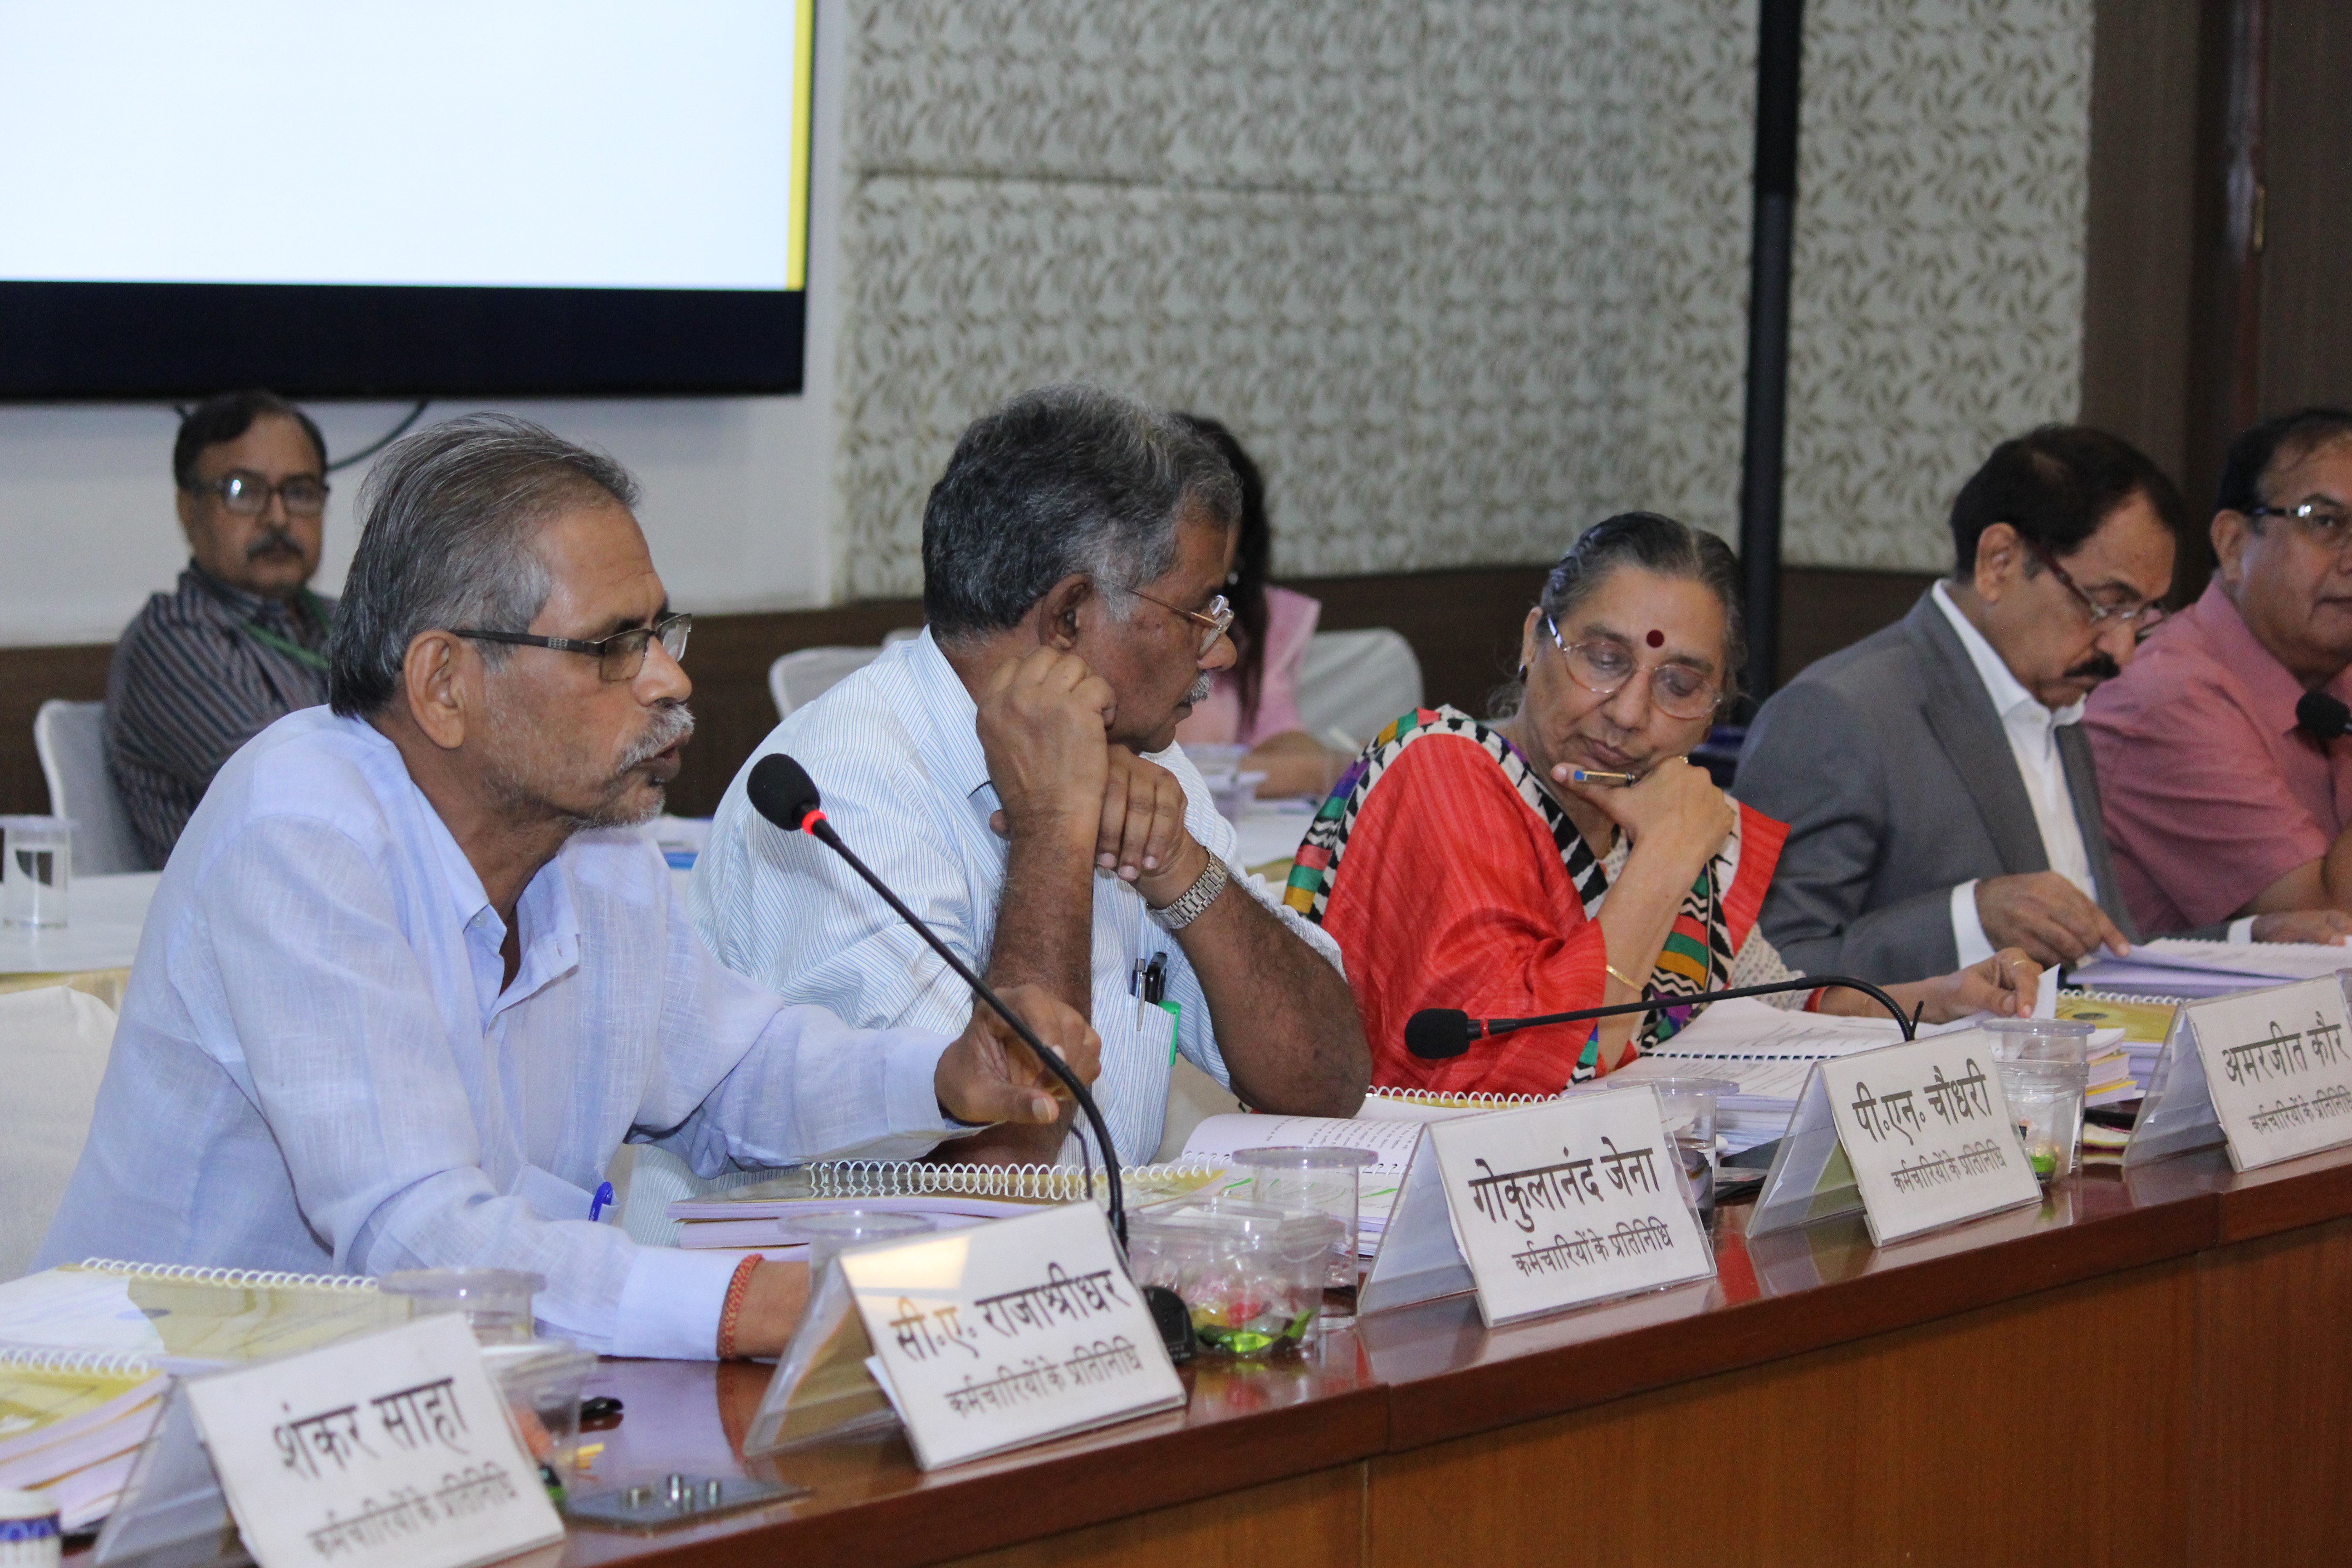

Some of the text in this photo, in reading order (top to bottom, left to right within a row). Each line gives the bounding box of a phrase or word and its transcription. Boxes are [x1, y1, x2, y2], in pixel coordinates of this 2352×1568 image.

[2222, 1011, 2351, 1086] अमरजीत कौर
[1923, 1058, 1992, 1126] चौधरी
[2249, 1097, 2306, 1135] कर्मचारियों
[2297, 1094, 2314, 1122] के
[1468, 1147, 1604, 1232] गोकुलानंद
[1600, 1136, 1660, 1197] जेना
[1891, 1139, 2007, 1194] कर्मचारियों के प्रतिनिधि
[1512, 1216, 1673, 1277] कर्मचारियों के प्रतिनिधि
[974, 1262, 1131, 1337] राजाश्रीधर
[1064, 1336, 1143, 1387] प्रतिनिधि
[273, 1377, 469, 1480] शंकर साहा
